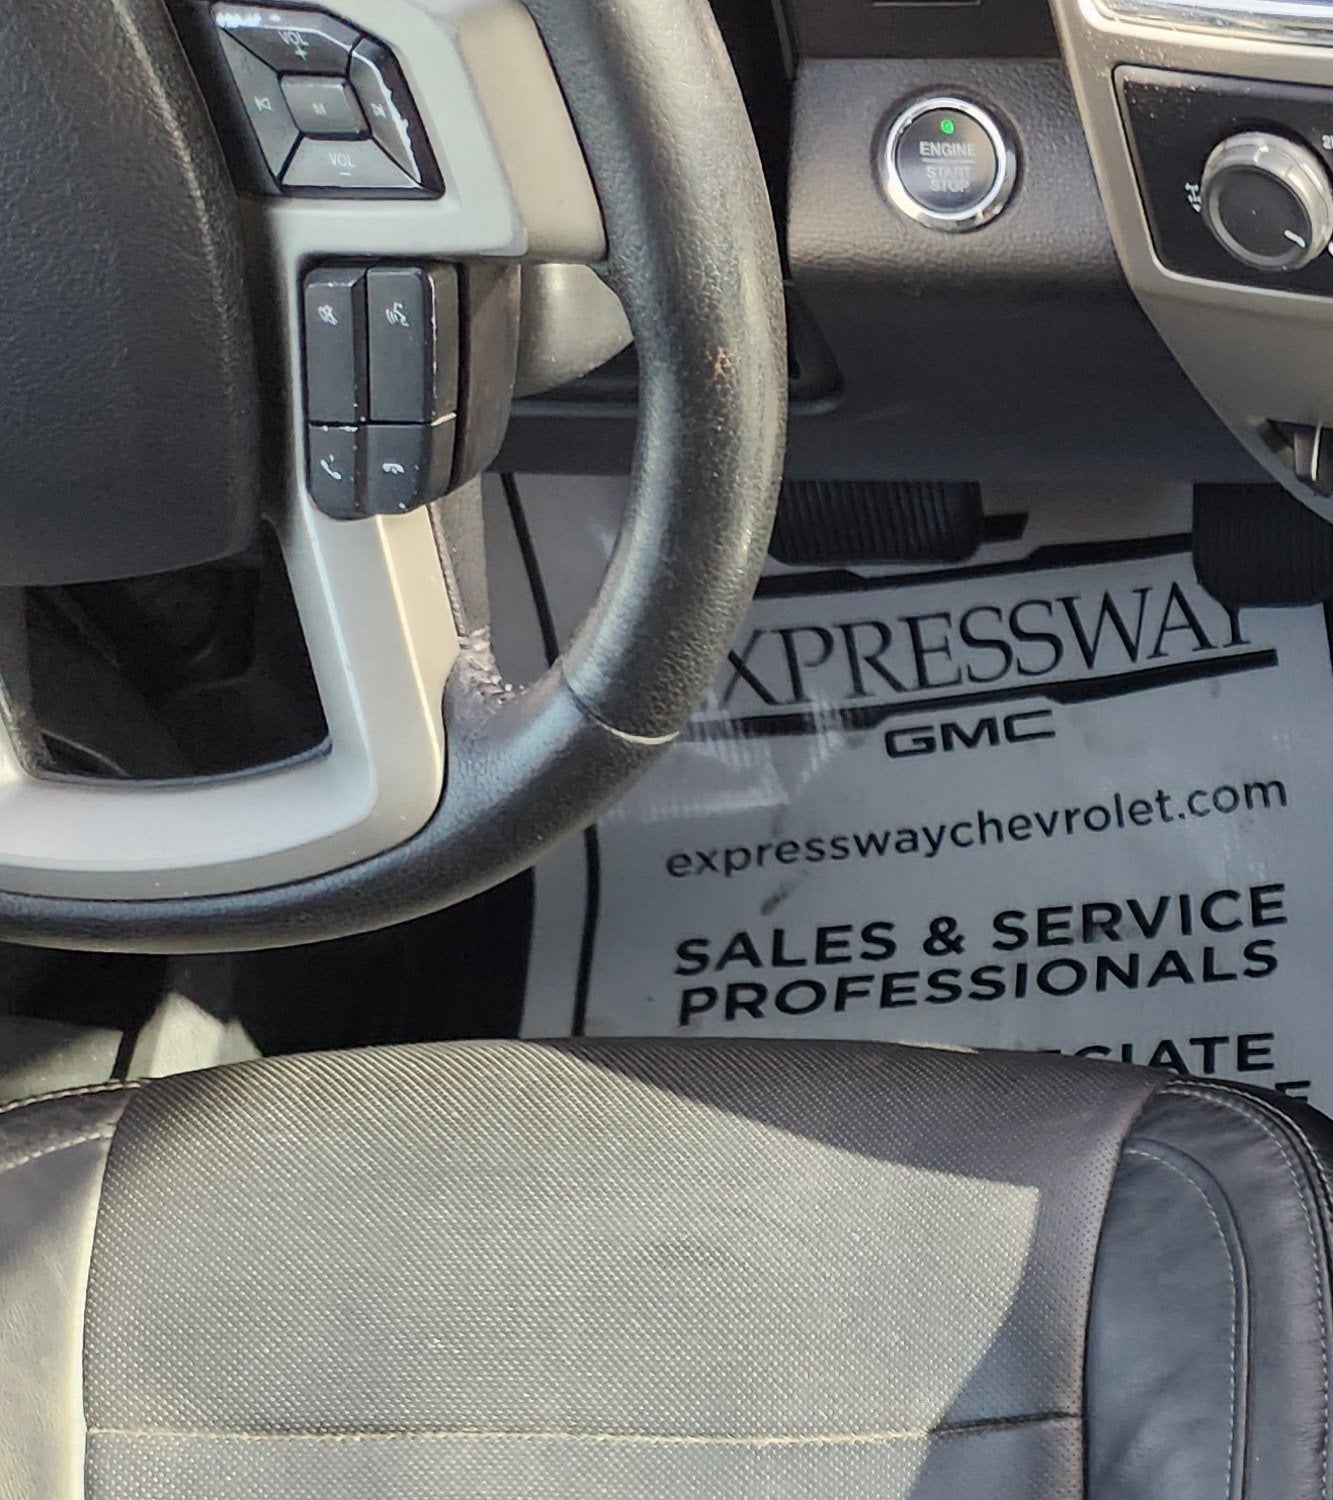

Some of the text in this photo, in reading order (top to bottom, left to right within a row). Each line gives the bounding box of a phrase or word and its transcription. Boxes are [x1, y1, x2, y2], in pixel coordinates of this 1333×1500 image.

[278, 30, 309, 46] VOL
[329, 153, 355, 168] VOL
[919, 141, 976, 156] ENGINE
[926, 165, 971, 178] START
[930, 180, 970, 193] STOP
[721, 581, 1252, 708] XPRESSWA
[884, 709, 1056, 759] GMC
[665, 777, 1288, 878] expresswaychevrolet.com
[674, 882, 1288, 976] SALES & SERVICE
[678, 938, 1280, 1027] PROFESSIONALS
